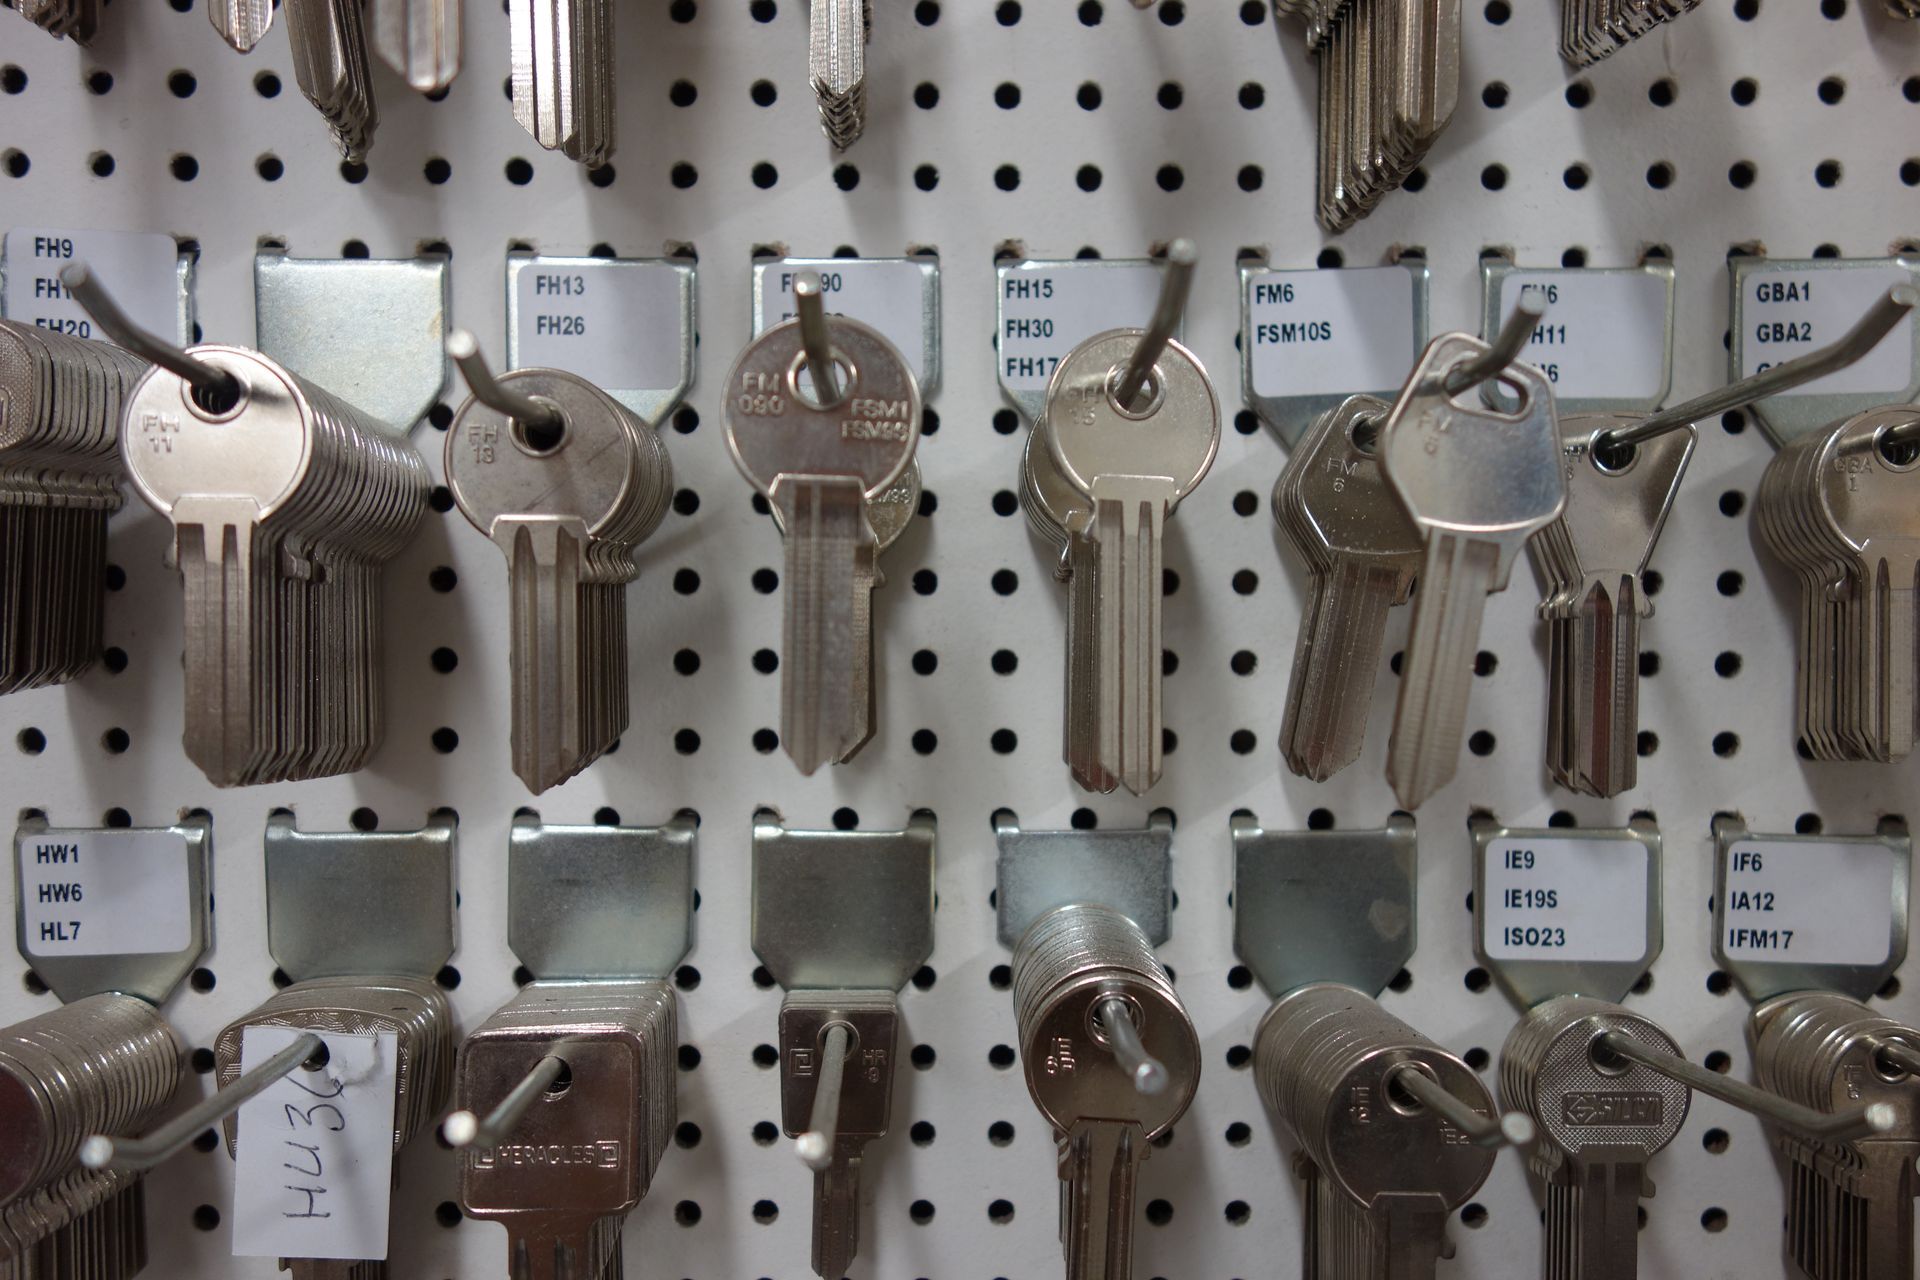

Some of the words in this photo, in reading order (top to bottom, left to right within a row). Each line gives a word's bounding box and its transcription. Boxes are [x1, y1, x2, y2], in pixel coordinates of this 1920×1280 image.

[35, 237, 73, 258] FH9
[536, 275, 585, 295] FH13
[1006, 279, 1053, 299] FH15
[1256, 283, 1294, 304] FM6
[1756, 281, 1809, 302] GBA1
[537, 315, 585, 335] FH26
[1006, 319, 1053, 338] FH30
[1257, 321, 1331, 344] FSM10S
[1531, 325, 1566, 344] H11
[1756, 322, 1811, 343] GBA2
[1007, 357, 1059, 377] FH17
[143, 415, 179, 432] FH
[468, 424, 498, 443] FH
[149, 436, 171, 453] 11
[473, 444, 494, 464] 13
[1326, 457, 1358, 476] FM
[37, 844, 79, 864] HW1
[1505, 850, 1535, 869] IE9
[1733, 852, 1762, 872] IF6
[39, 883, 83, 903] HW6
[1504, 889, 1558, 908] IE19S
[1731, 891, 1775, 911] IA12
[41, 921, 81, 941] HL7
[1504, 927, 1566, 947] ISO23
[1729, 929, 1793, 949] IFM17
[498, 1144, 595, 1165] HERACLES
